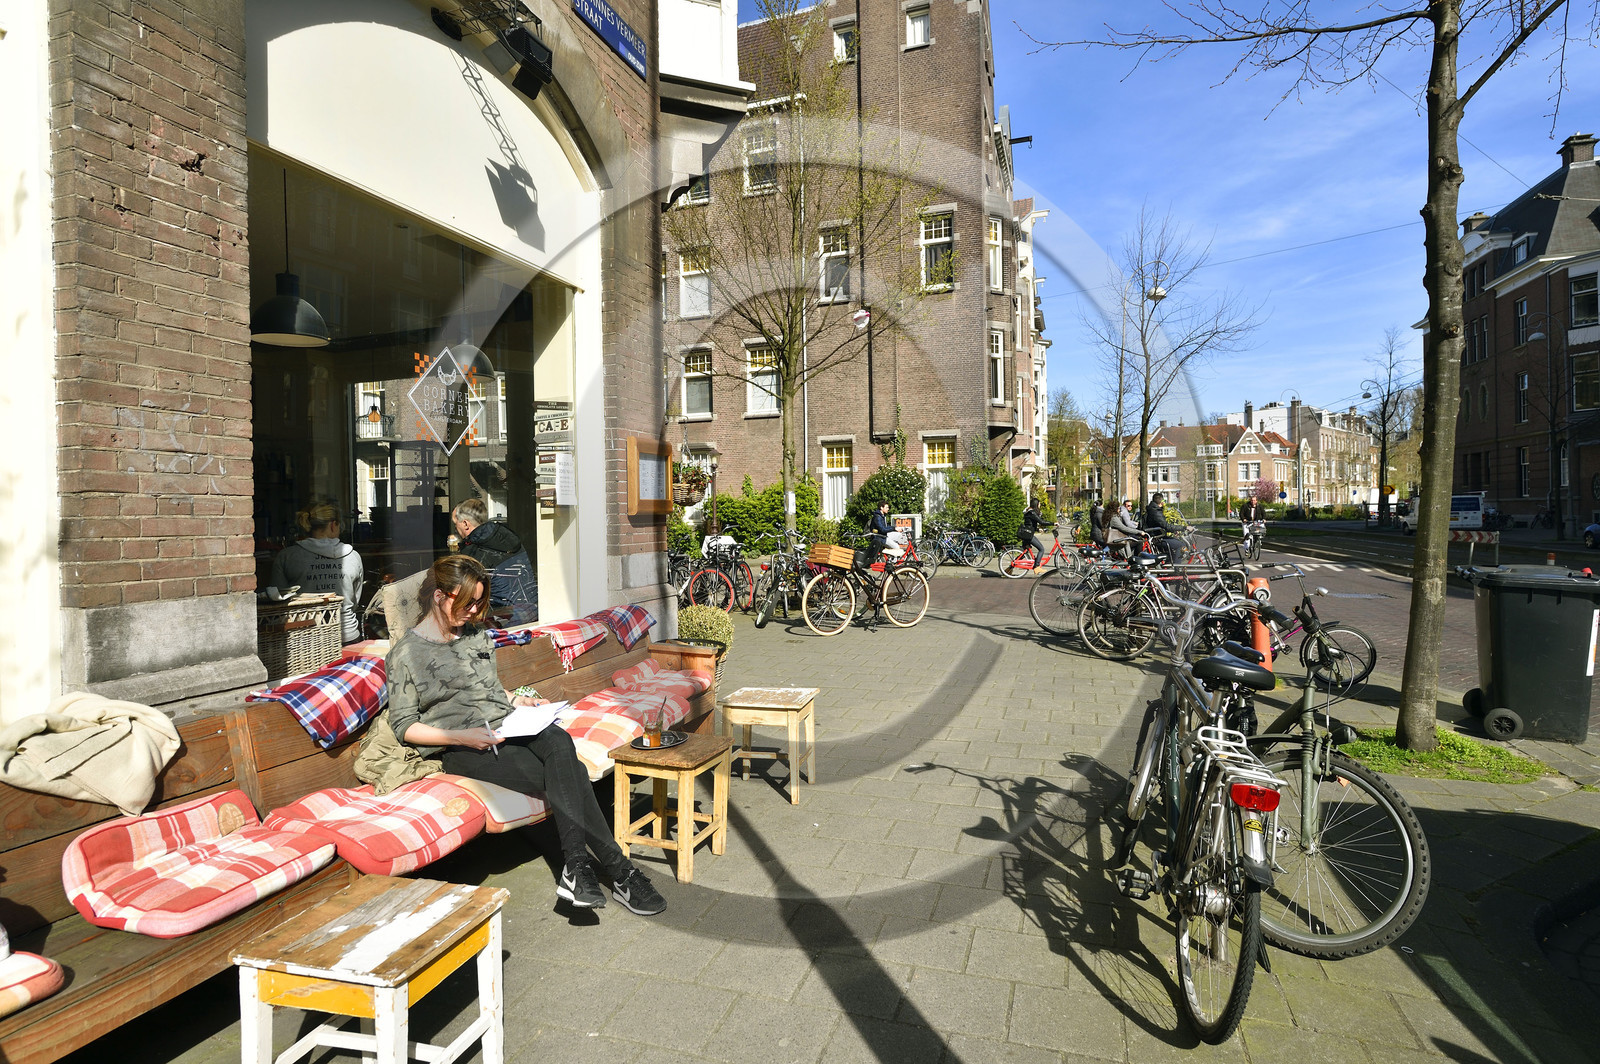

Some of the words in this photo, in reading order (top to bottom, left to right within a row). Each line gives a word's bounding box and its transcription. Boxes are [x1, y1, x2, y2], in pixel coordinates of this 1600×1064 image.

[575, 0, 603, 30] STRAAT
[615, 16, 646, 59] VERMEER
[538, 419, 569, 433] CAFE
[306, 573, 345, 581] MATTHEW
